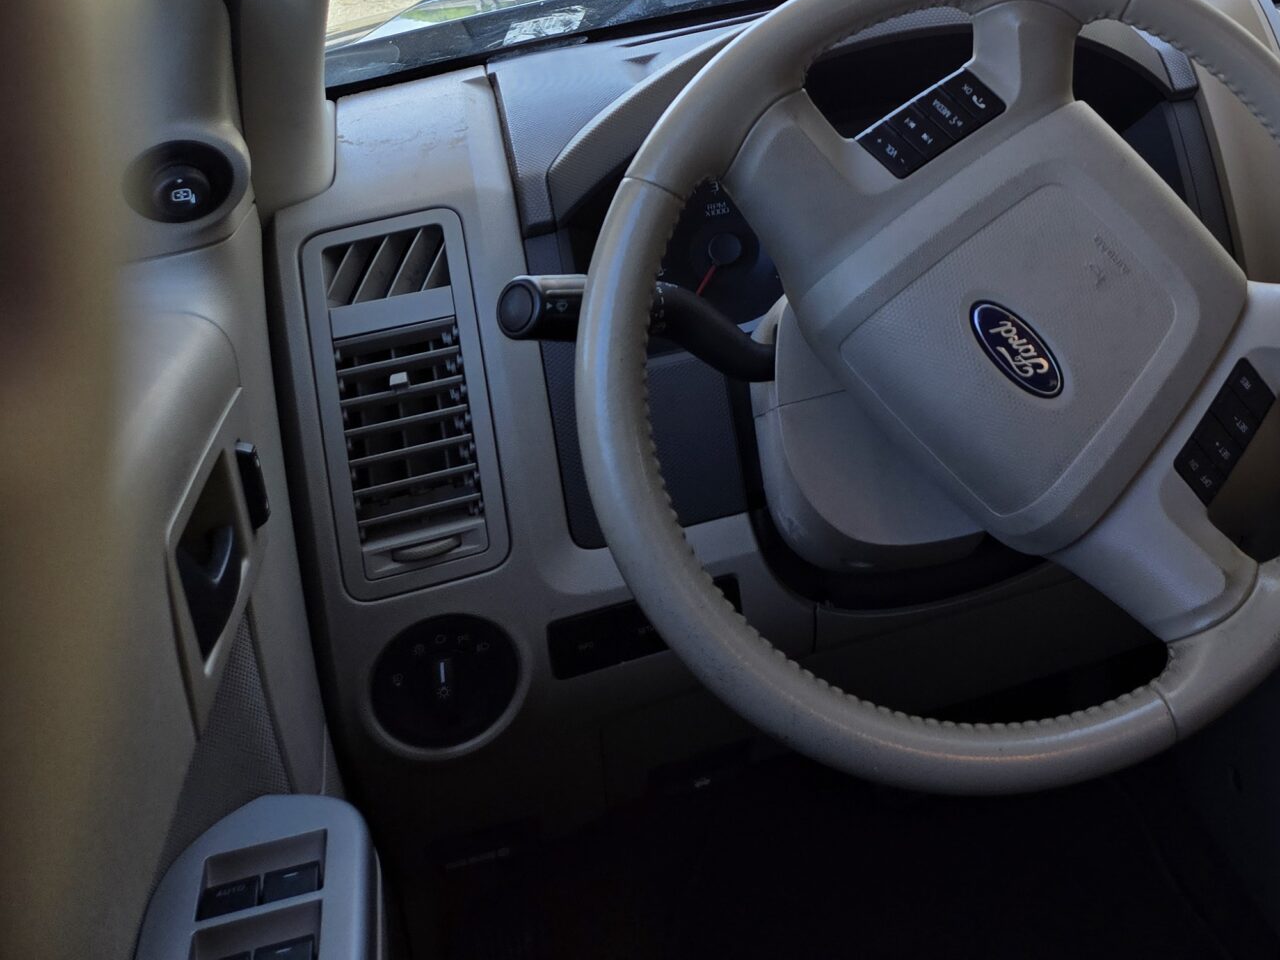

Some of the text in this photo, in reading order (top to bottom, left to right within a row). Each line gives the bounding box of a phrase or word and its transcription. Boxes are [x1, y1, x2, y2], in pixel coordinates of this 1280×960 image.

[932, 99, 951, 118] MEDIA
[988, 320, 1049, 378] Ford
[215, 884, 245, 898] AUTO
